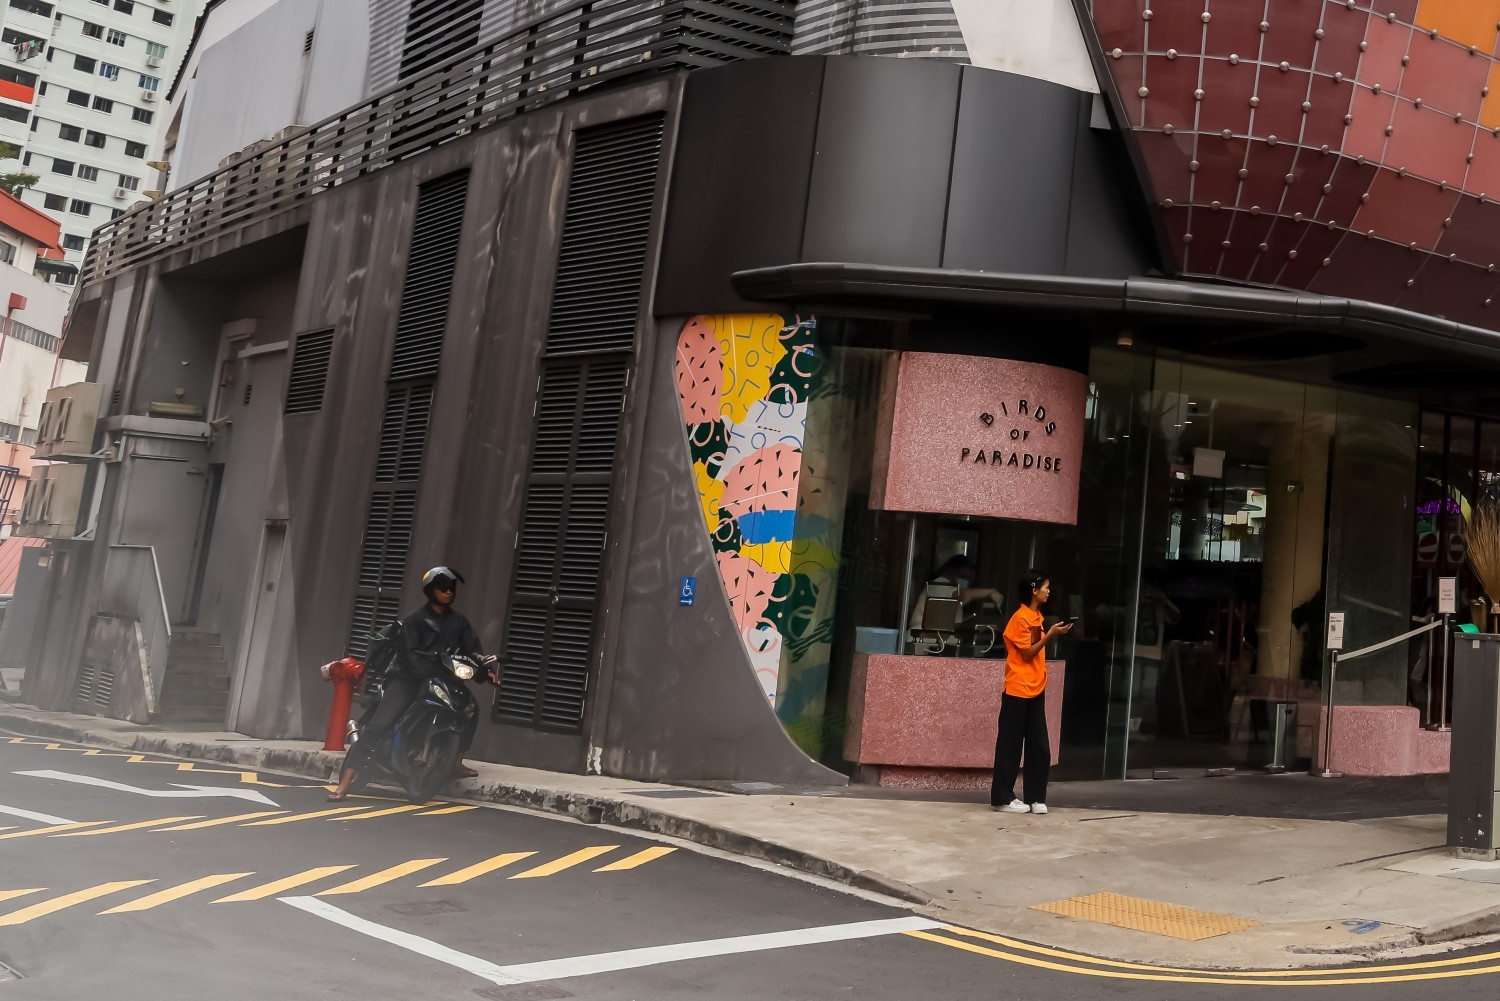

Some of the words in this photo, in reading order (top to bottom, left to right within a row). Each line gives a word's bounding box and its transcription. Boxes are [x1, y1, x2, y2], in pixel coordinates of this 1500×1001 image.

[980, 400, 1056, 434] BIRDS
[1010, 428, 1030, 440] OF
[961, 447, 1062, 471] PARADISE
